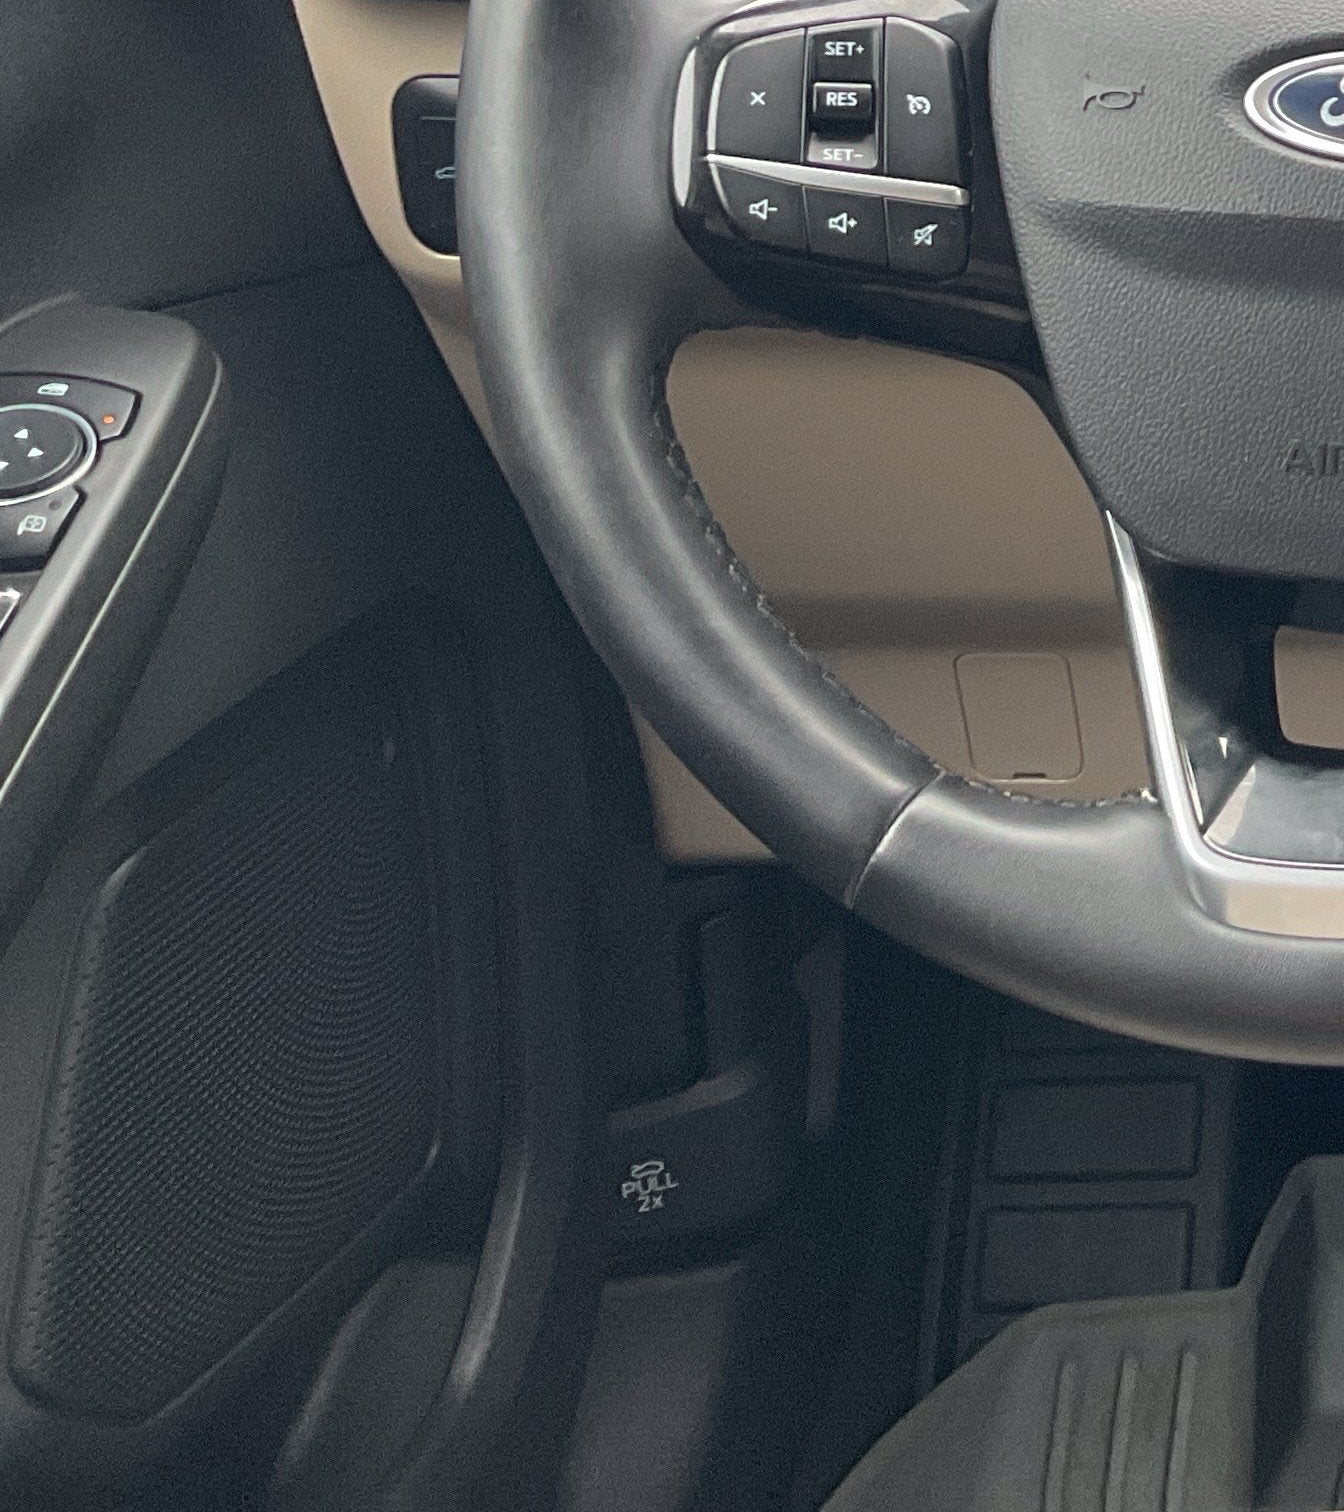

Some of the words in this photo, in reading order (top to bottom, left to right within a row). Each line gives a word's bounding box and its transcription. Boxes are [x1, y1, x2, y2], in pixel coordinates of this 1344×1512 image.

[824, 41, 865, 56] SET+
[825, 91, 858, 107] RES
[822, 148, 865, 161] SET-
[621, 1173, 680, 1198] PULL
